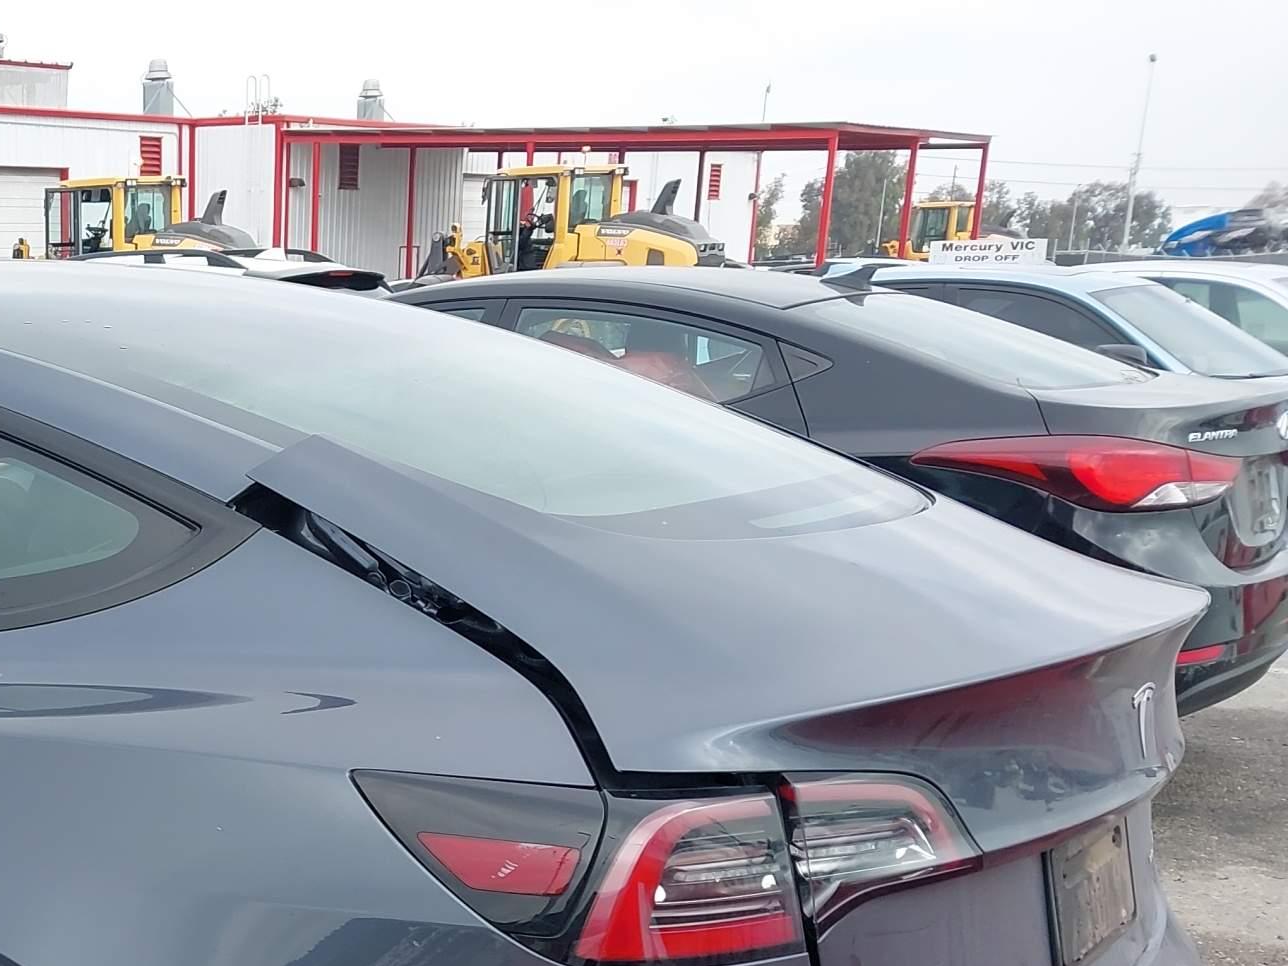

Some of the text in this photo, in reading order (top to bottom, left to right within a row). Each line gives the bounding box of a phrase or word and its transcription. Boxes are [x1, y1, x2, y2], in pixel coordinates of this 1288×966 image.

[941, 241, 1036, 253] Mercury VIC
[994, 254, 1020, 262] OFF
[1188, 429, 1239, 442] ELANTRA
